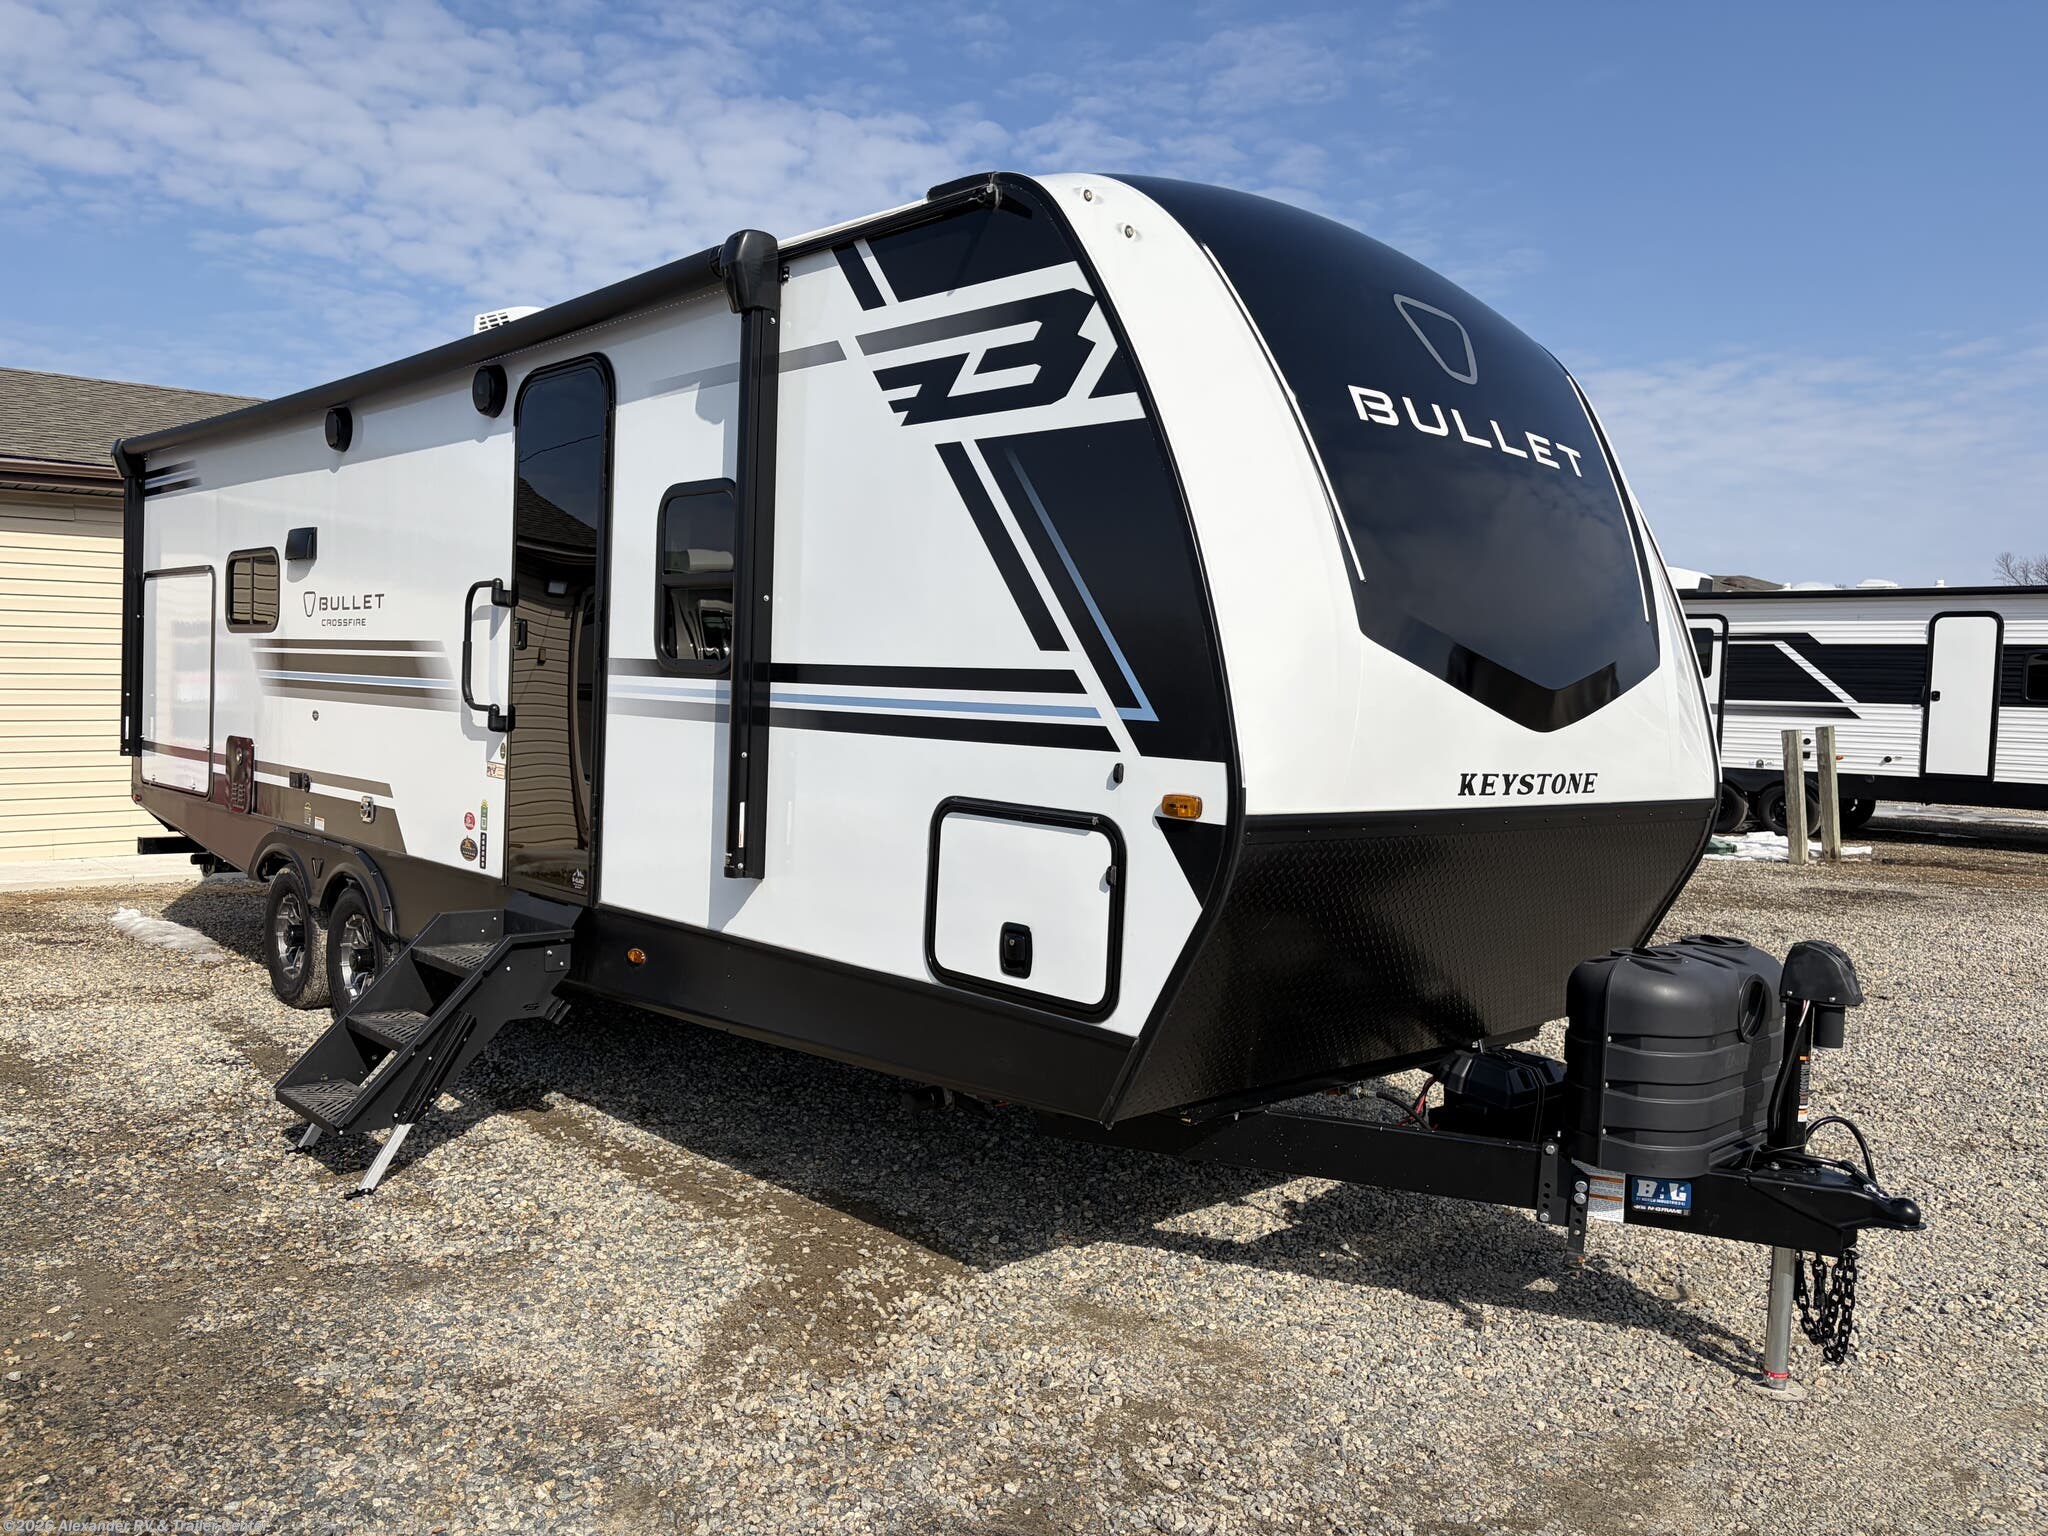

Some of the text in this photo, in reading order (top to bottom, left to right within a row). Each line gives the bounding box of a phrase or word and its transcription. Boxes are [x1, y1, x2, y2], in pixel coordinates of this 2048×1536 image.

[1348, 384, 1582, 477] BULLET
[319, 593, 385, 611] BULLET
[321, 618, 367, 627] CROSSFIRE
[1457, 773, 1598, 796] KEYSTONE
